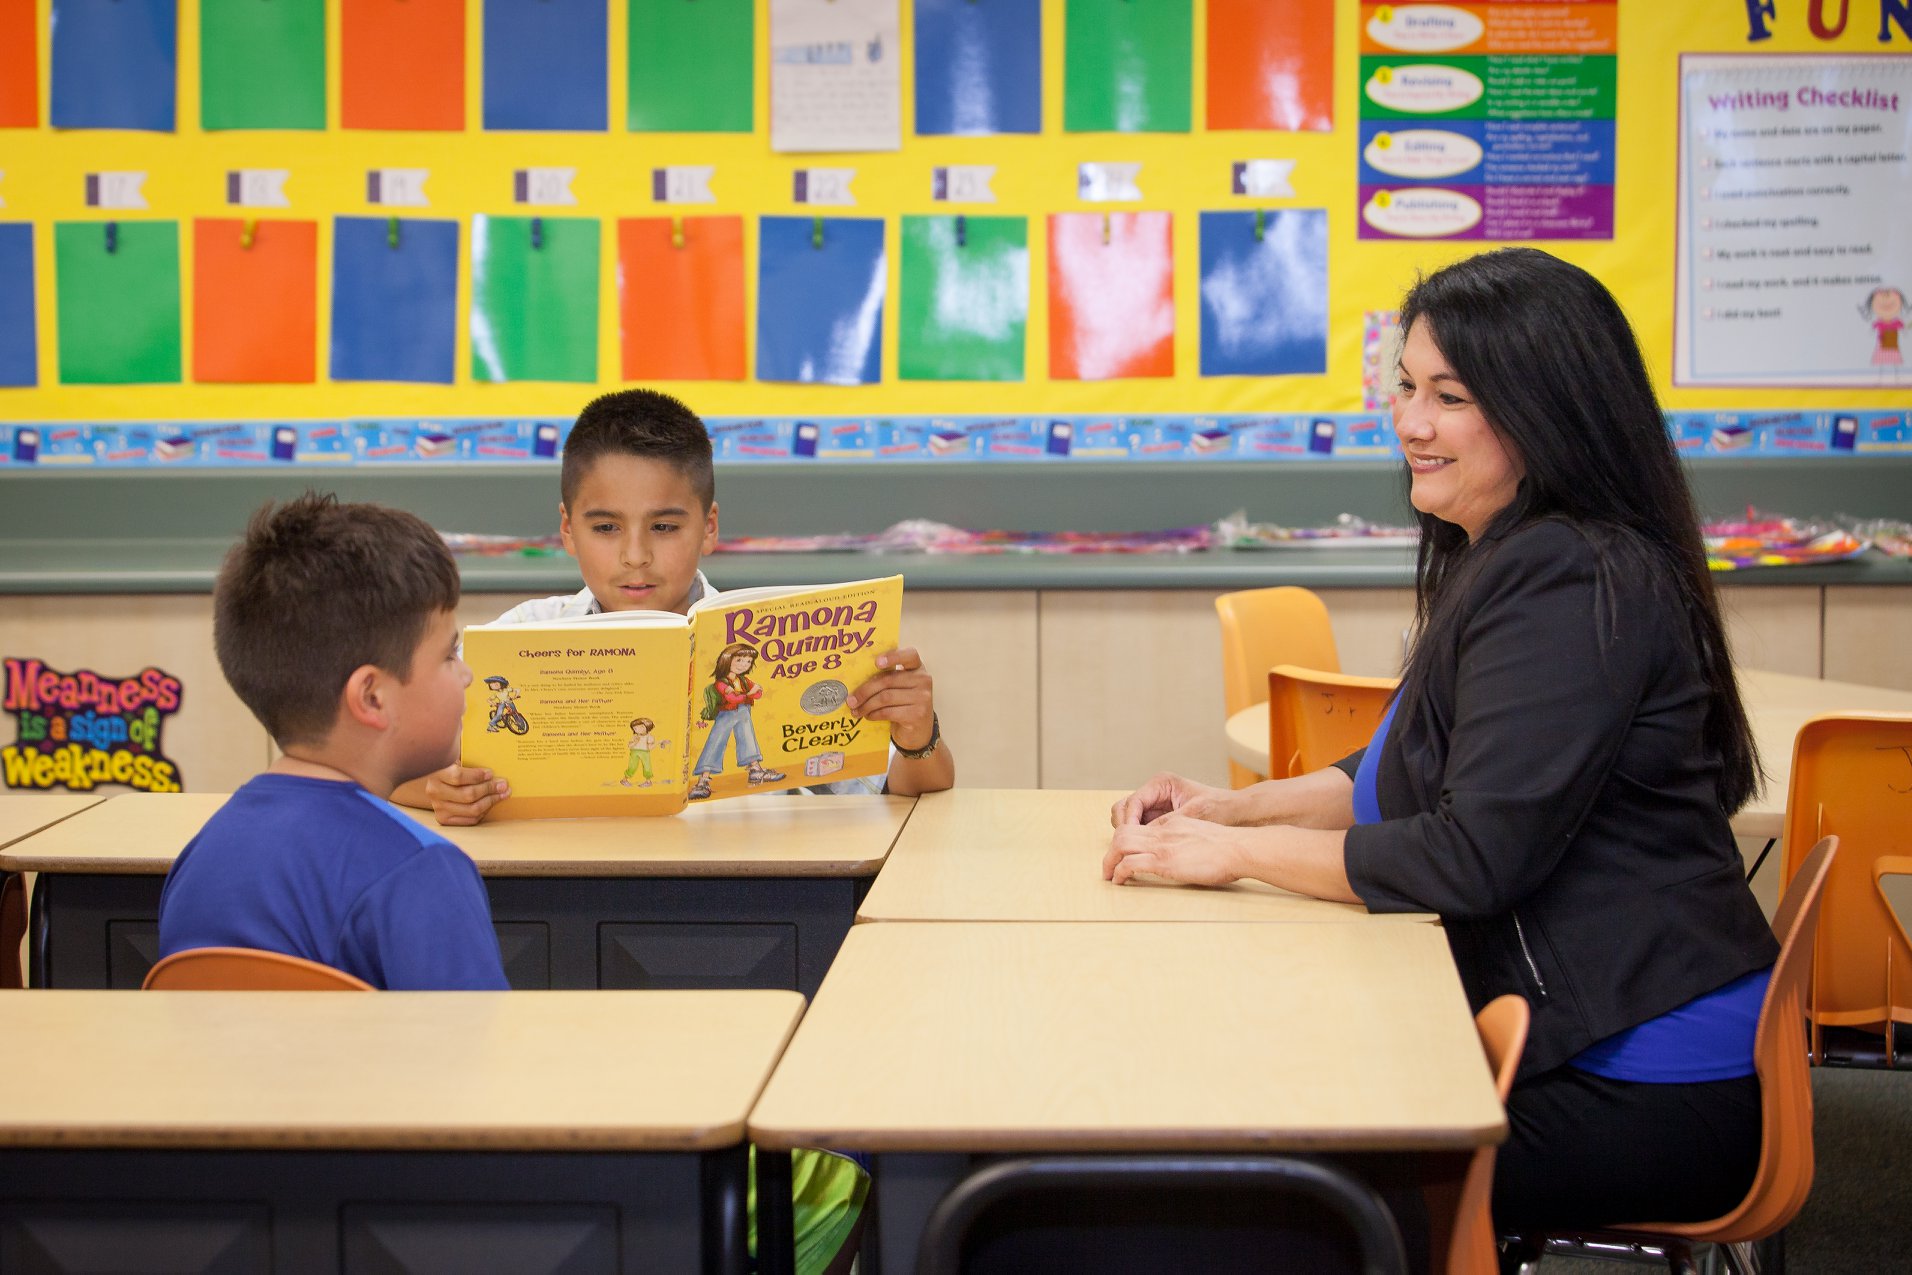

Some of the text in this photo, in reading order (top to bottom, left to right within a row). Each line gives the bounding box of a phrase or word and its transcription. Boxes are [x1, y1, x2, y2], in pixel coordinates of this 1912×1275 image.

[1708, 86, 1899, 112] Writing Checklist
[756, 605, 786, 614] SPECIAL
[843, 590, 875, 600] EDITION
[725, 600, 878, 645] Ramona
[518, 647, 636, 659] Cheers for RAMONA
[760, 627, 876, 663] Quimby,
[771, 654, 842, 680] Age 8
[4, 659, 180, 714] Meanness
[20, 707, 160, 751] is a sign of
[2, 743, 181, 793] Weakness.
